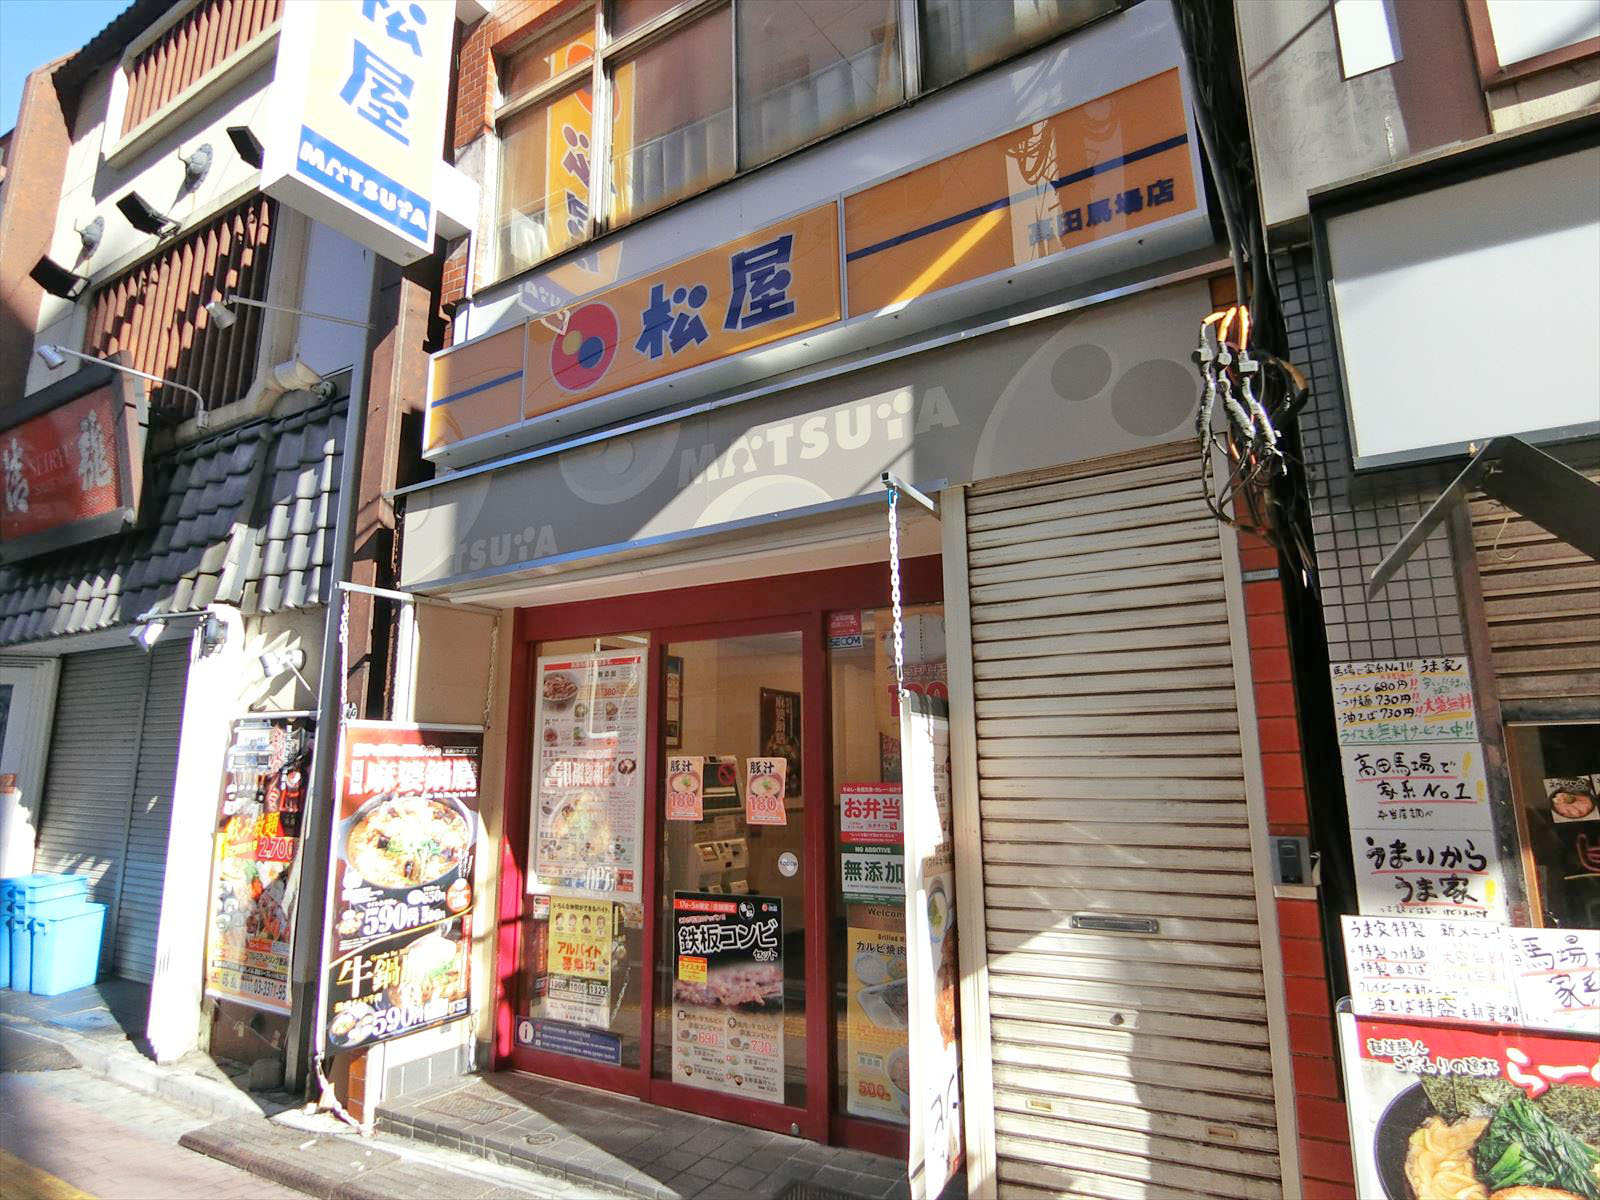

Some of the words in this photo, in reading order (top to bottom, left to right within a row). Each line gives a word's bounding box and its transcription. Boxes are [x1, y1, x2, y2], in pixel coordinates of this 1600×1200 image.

[299, 139, 428, 231] MATSUYA
[1028, 178, 1174, 246] 田馬場店
[635, 234, 795, 360] 松屋
[678, 385, 960, 486] MATSUYA
[451, 524, 560, 574] TSUYA
[1421, 659, 1463, 673] うま家
[1339, 682, 1371, 695] ラーメン
[1343, 696, 1373, 707] つけ麺
[1423, 693, 1472, 714] 大盛無料
[670, 759, 693, 773] 豚汁
[750, 761, 775, 775] 豚汁
[670, 791, 696, 808] 180
[750, 796, 777, 812] 180
[844, 797, 901, 820] お弁当
[1365, 836, 1488, 872] うまいから
[844, 859, 905, 884] 無添加
[867, 908, 905, 918] Welcom
[678, 918, 779, 954] 鉄板コンビ
[557, 940, 602, 958] アルバイト
[752, 948, 778, 962] セット
[1521, 934, 1600, 974] 馬場
[1505, 1048, 1600, 1099] らー
